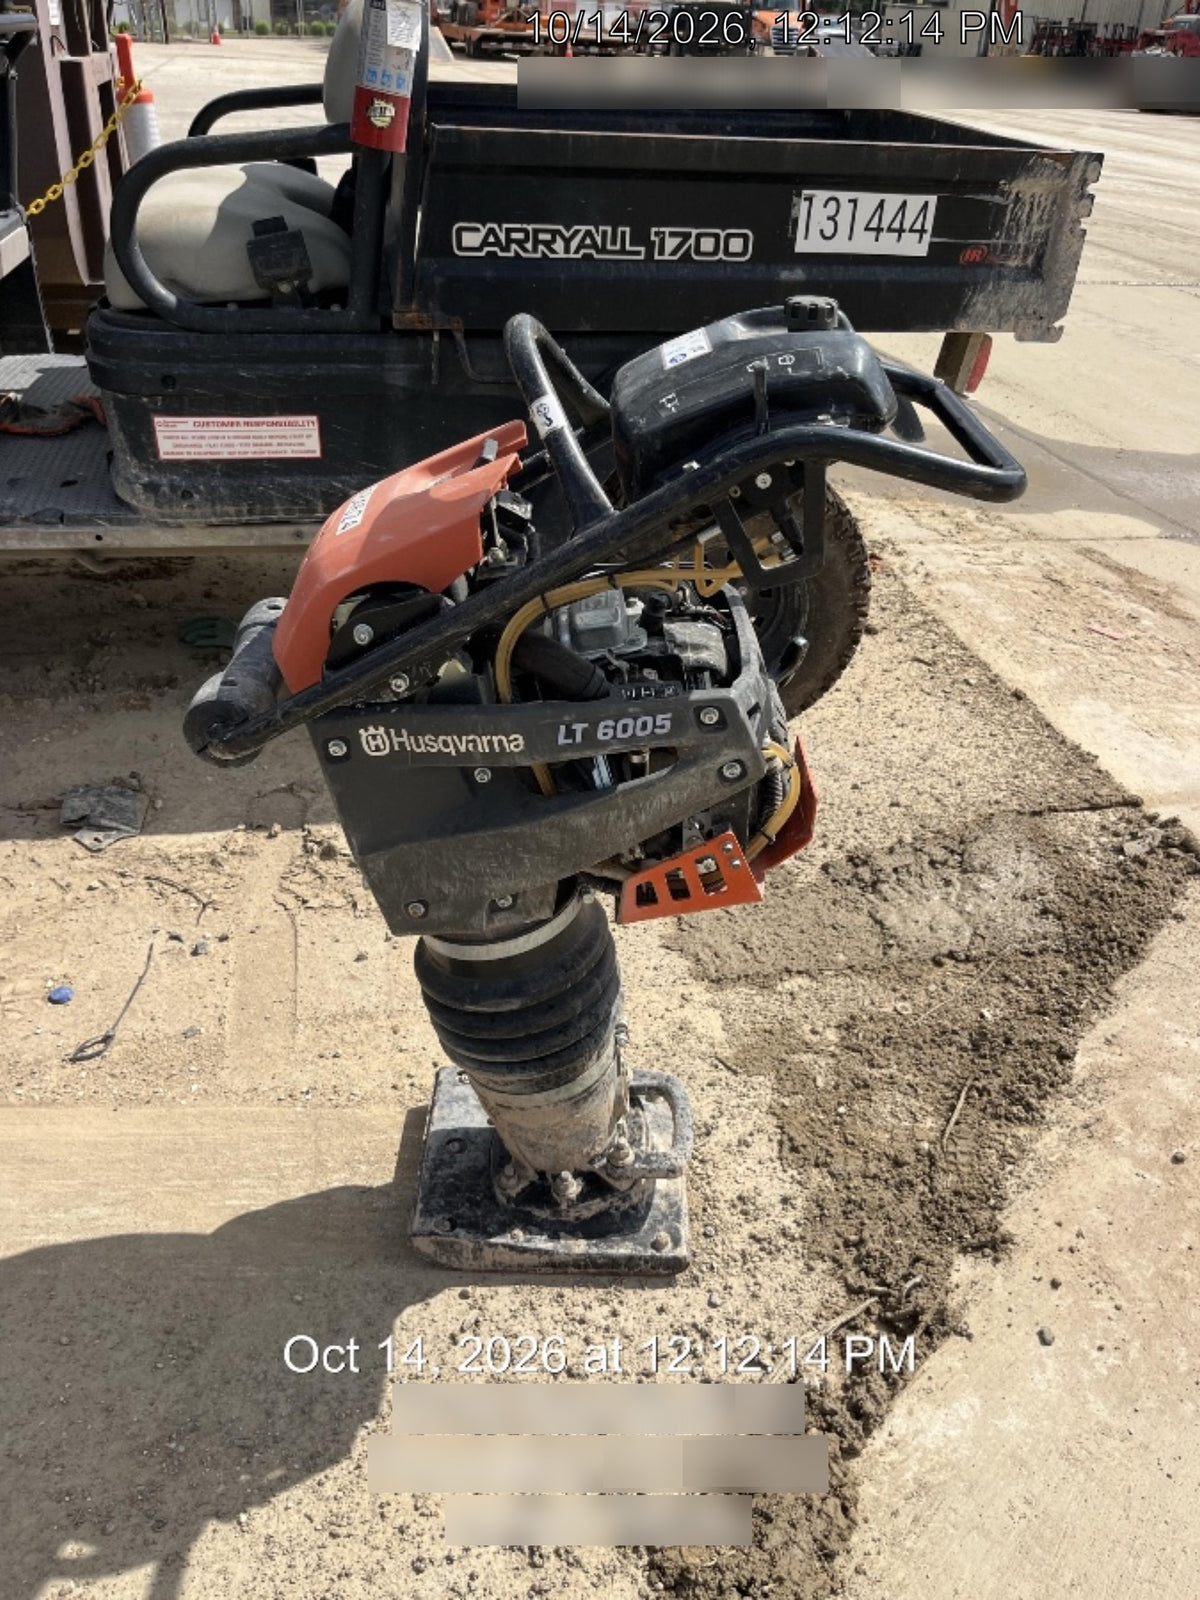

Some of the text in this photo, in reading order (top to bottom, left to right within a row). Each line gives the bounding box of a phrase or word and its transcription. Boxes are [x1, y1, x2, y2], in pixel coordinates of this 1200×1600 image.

[802, 193, 930, 244] 131444
[452, 221, 753, 262] CARRYALL 1700
[390, 728, 525, 756] Husqvarna
[557, 713, 673, 746] LT 6005
